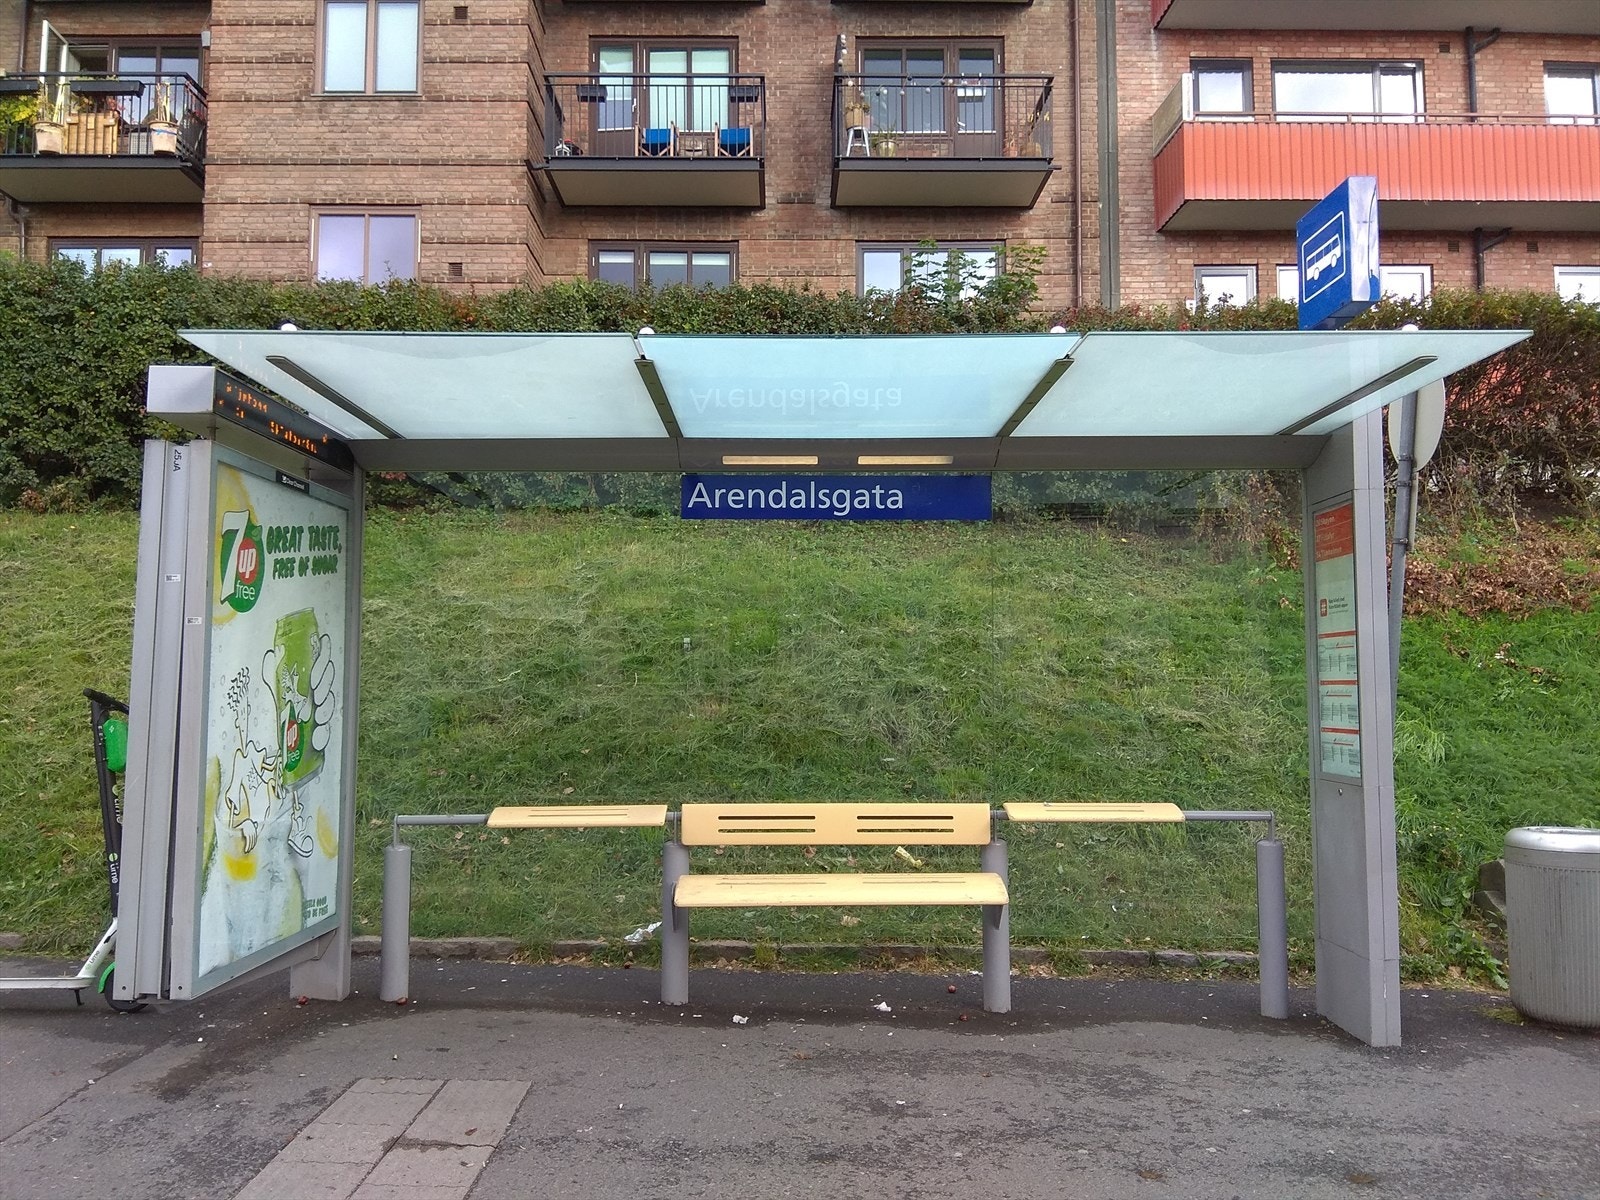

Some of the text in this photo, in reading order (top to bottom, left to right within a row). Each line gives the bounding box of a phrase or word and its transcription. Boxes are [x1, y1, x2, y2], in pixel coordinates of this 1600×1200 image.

[687, 481, 903, 517] Arendalsgata
[266, 525, 343, 554] GREAT TASTE,
[238, 548, 257, 579] up
[273, 553, 339, 580] FREE OF SUGAR
[235, 580, 256, 600] free
[110, 862, 120, 884] Lime
